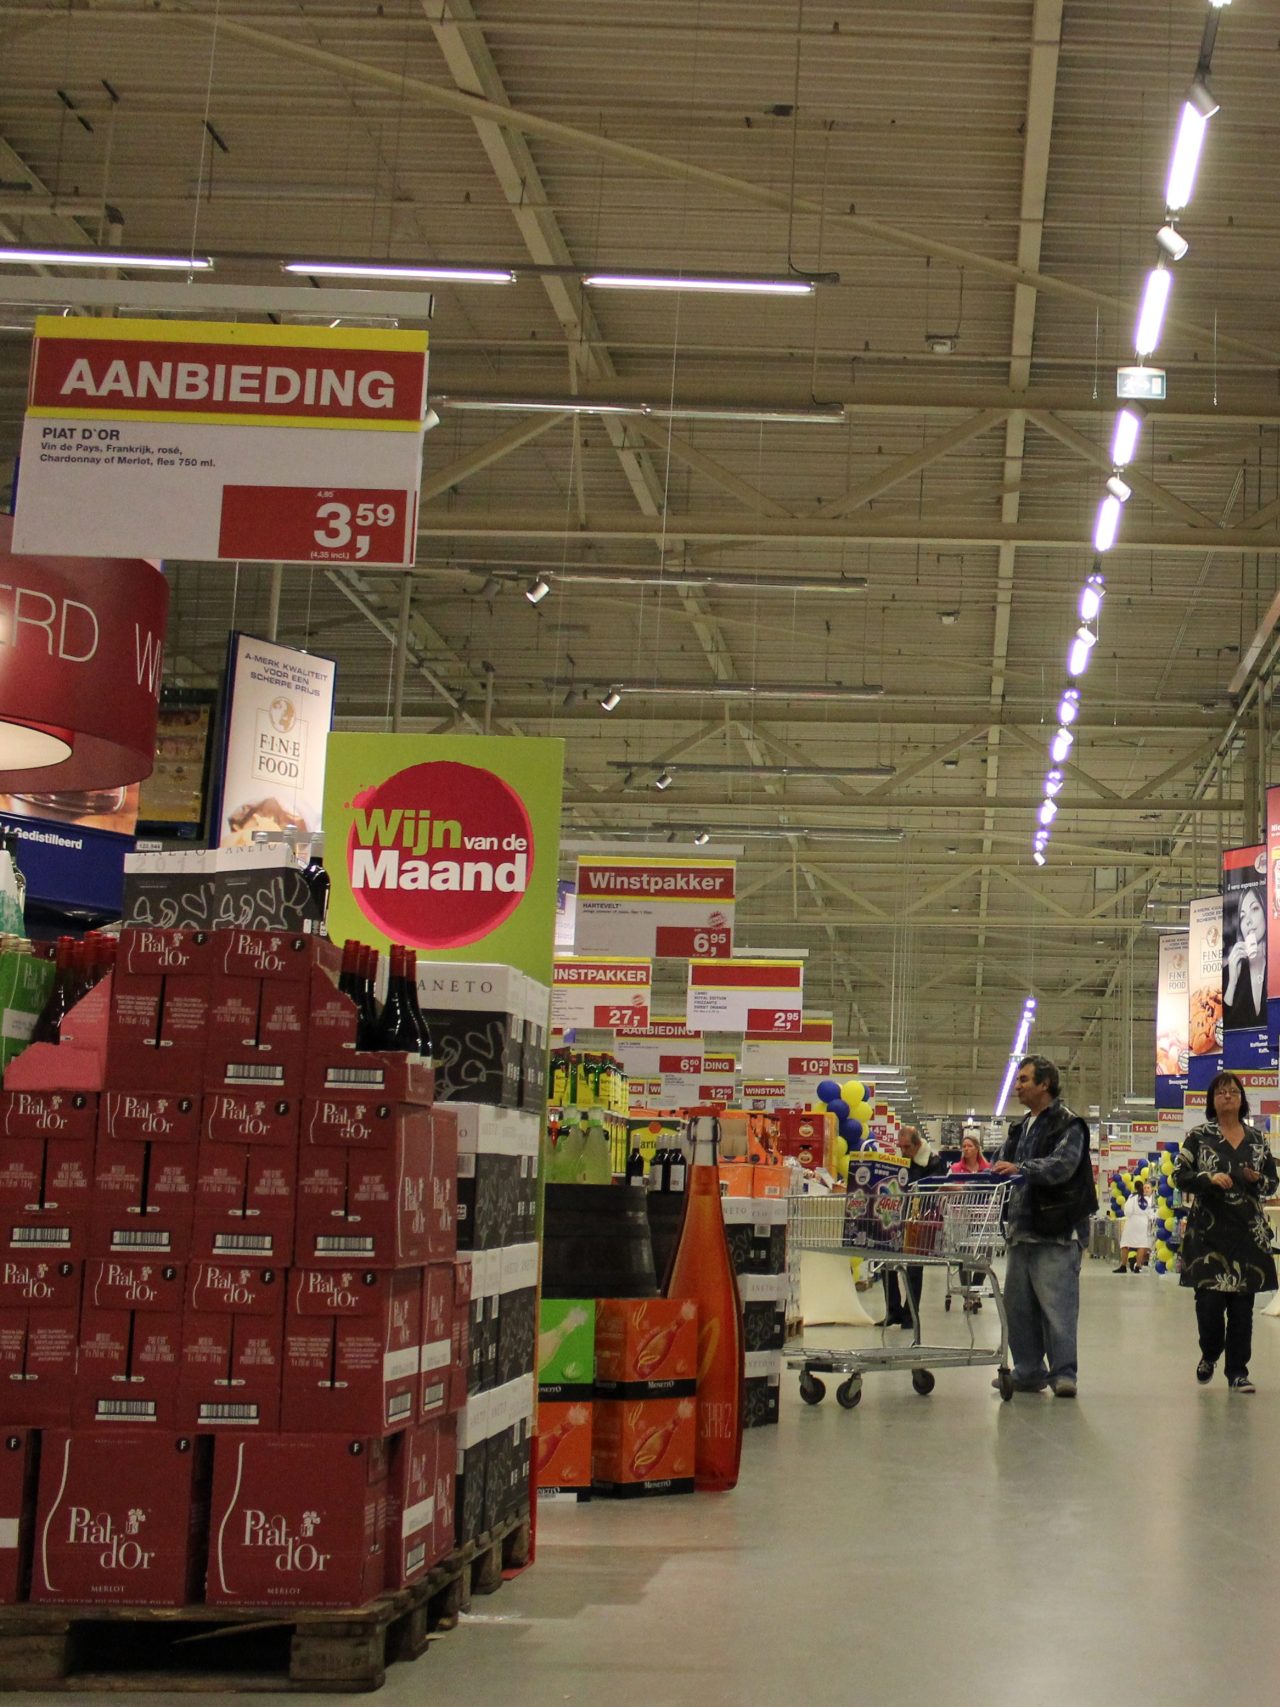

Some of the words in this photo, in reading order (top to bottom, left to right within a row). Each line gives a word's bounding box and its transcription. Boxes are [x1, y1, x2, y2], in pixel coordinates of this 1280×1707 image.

[60, 358, 395, 408] AANBIEDING
[42, 427, 77, 439] PIAT
[40, 442, 57, 450] Vin
[60, 443, 73, 451] de
[76, 444, 103, 453] Pays,
[106, 444, 154, 455] Frankrijk,
[157, 446, 183, 456] rosé,
[40, 453, 102, 465] Chardonnay
[104, 455, 115, 464] of
[117, 456, 153, 466] Merlot,
[156, 457, 175, 466] fles
[178, 458, 198, 467] 750
[200, 459, 216, 467] ml.
[0, 584, 99, 662] RD
[245, 652, 280, 668] A-MERK
[282, 663, 328, 681] KWALITEIT
[263, 666, 289, 679] VOOR
[291, 674, 310, 686] EEN
[250, 671, 293, 689] SCHERPE
[294, 684, 321, 697] PRIJS
[258, 755, 299, 778] FOOD
[15, 827, 83, 850] Gedistilleerd
[353, 808, 462, 856] Wijn
[463, 836, 498, 850] van
[502, 834, 528, 851] de
[351, 849, 528, 892] Maand
[588, 871, 725, 893] Winstpakker
[553, 968, 648, 982] INSTPAKKER
[417, 979, 493, 993] ANETO
[832, 1062, 854, 1072] ATIS
[1250, 1076, 1279, 1085] GRAT
[745, 1088, 785, 1096] WINSTPAK
[66, 1506, 115, 1544] Piat
[241, 1509, 291, 1546] Piat
[91, 1585, 125, 1593] MERLOT
[267, 1587, 302, 1595] MERLOT
